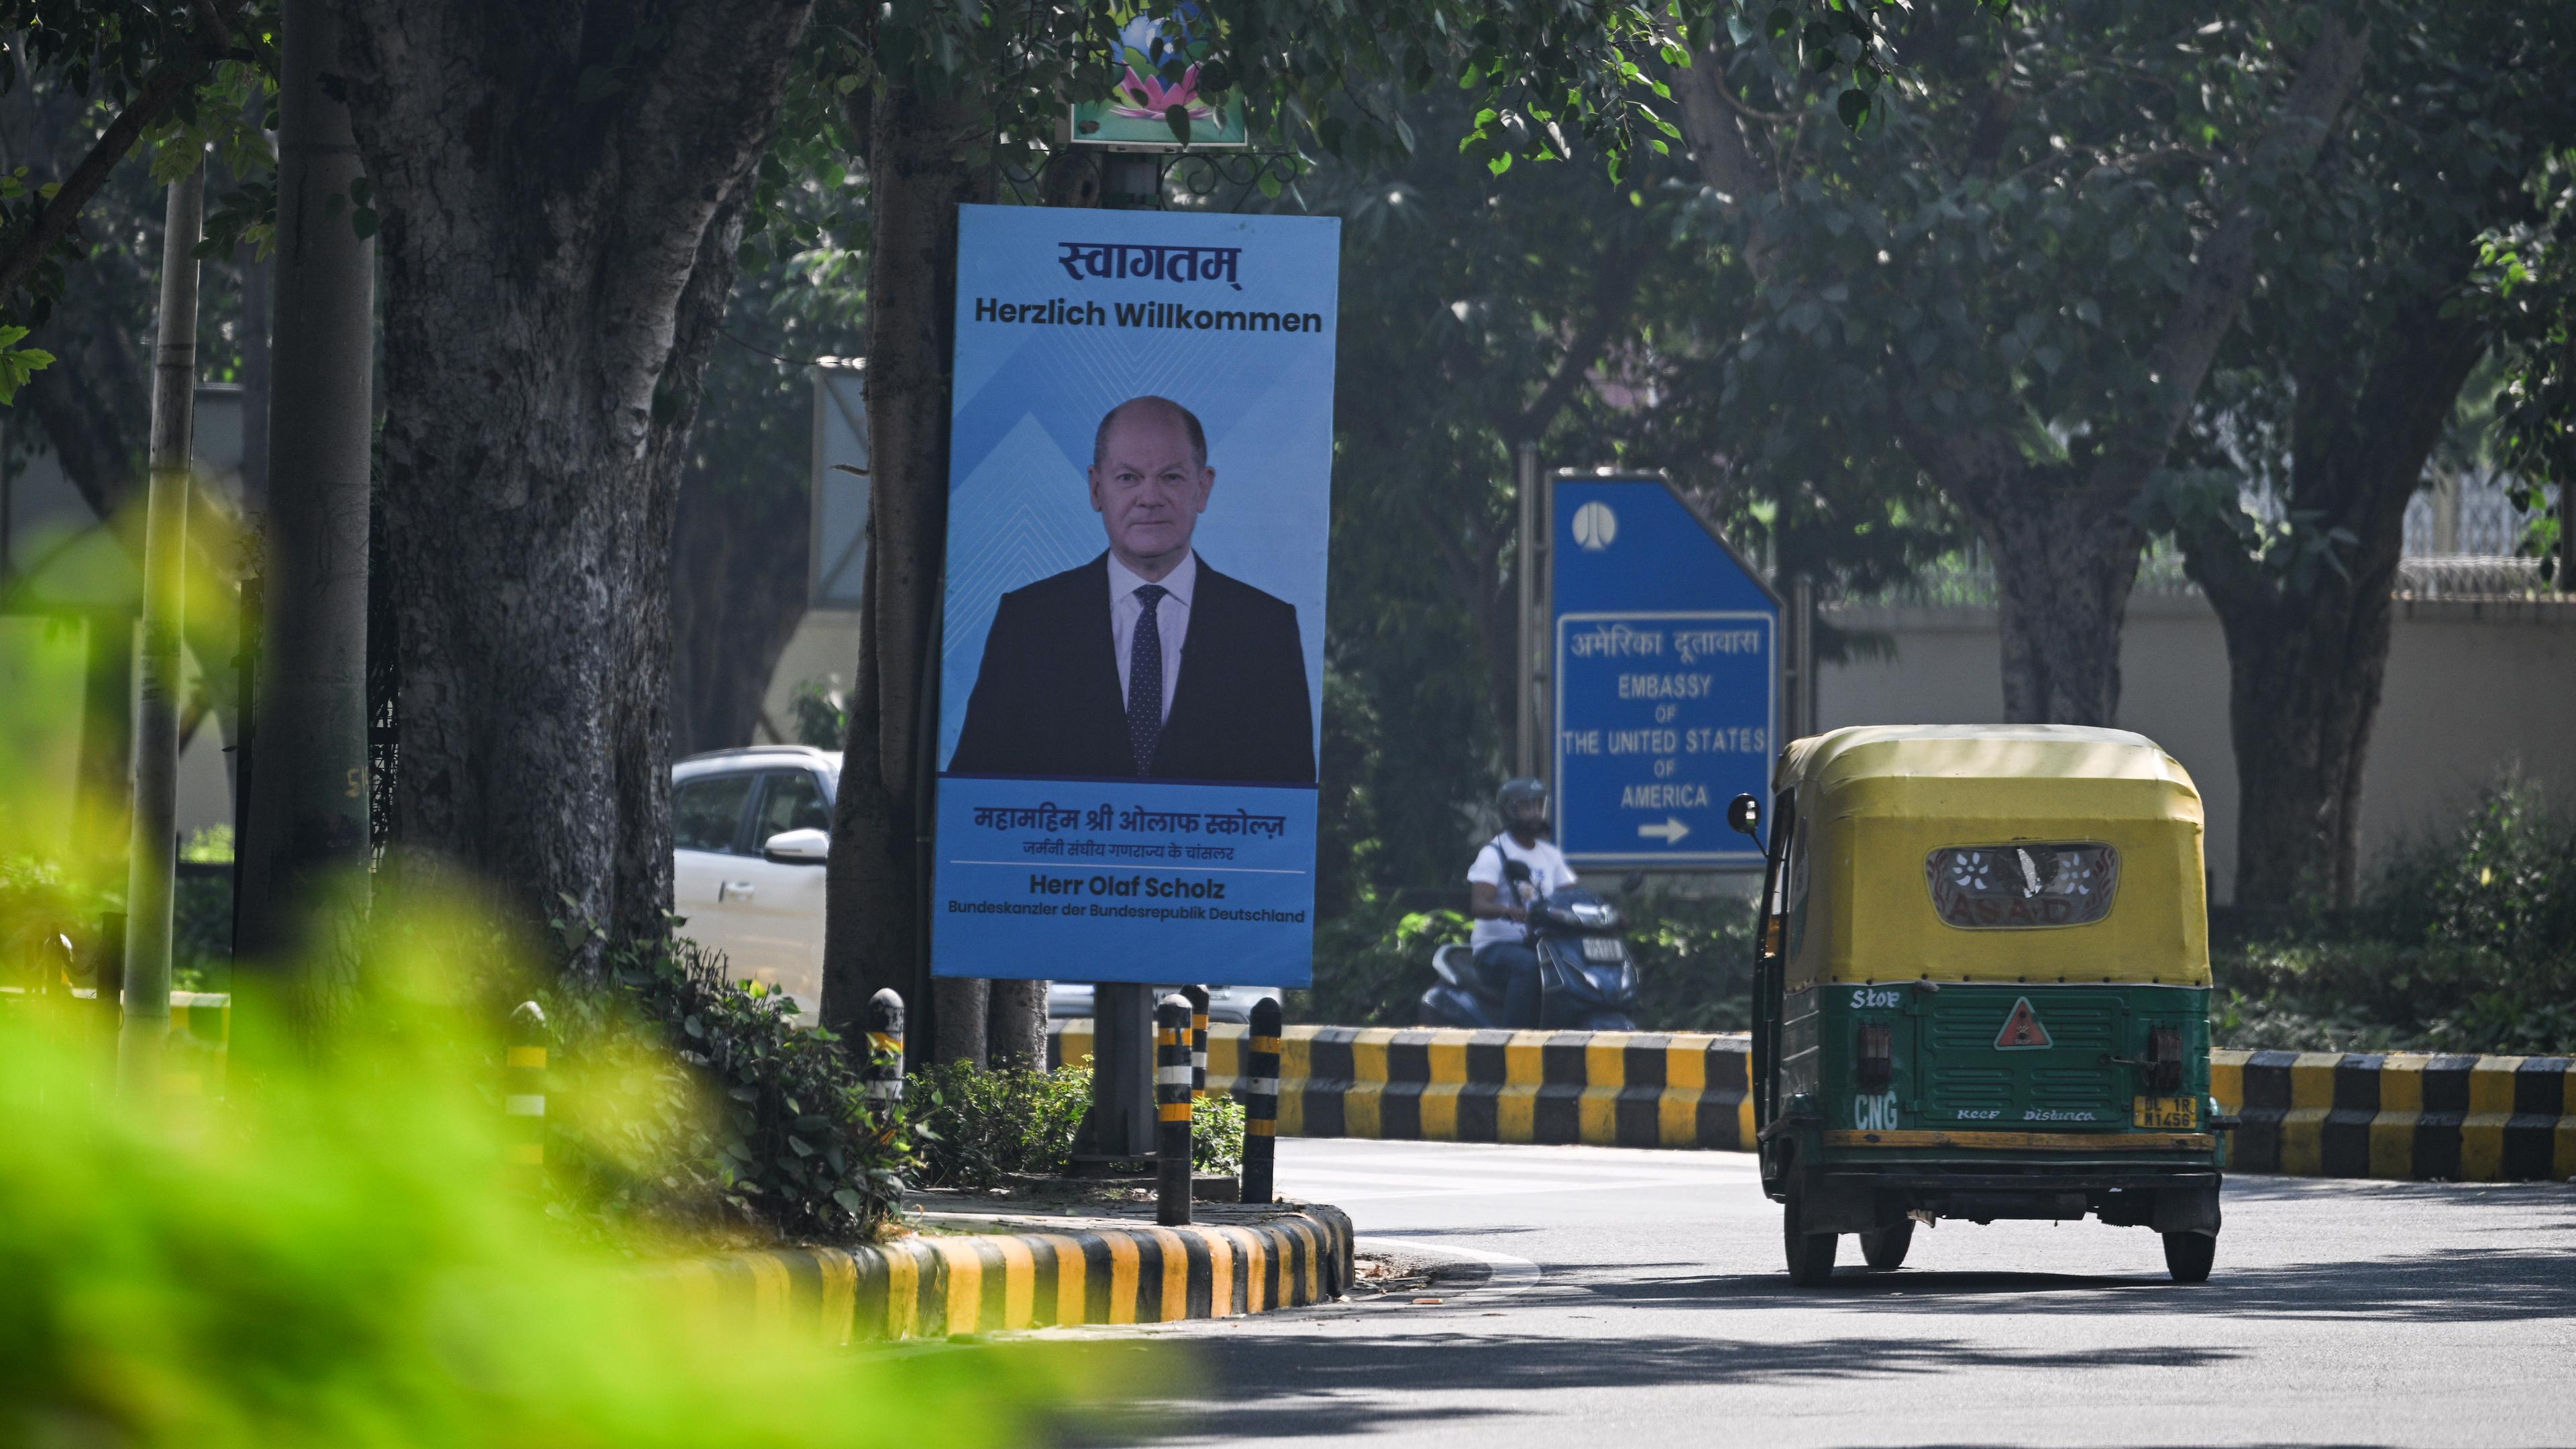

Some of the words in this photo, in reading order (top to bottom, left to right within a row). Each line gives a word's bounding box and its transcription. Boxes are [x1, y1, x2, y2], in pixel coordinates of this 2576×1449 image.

[1059, 242, 1242, 291] स्वागतम्
[975, 298, 1106, 327] Herzlich
[1114, 301, 1322, 333] Willkommen
[1570, 623, 1662, 657] अमेरिका
[1672, 629, 1761, 663] दूतावास
[1618, 674, 1711, 698] EMBASSY
[1654, 704, 1677, 724] OF
[1563, 730, 1599, 755] THE
[1608, 729, 1676, 755] UNITED
[1686, 728, 1766, 753] STATES
[1654, 759, 1675, 778] OF
[1621, 784, 1709, 809] AMERICA
[973, 801, 1080, 832] महामहिम
[1084, 803, 1114, 831] श्री
[1118, 805, 1201, 833] ओलाफ
[1204, 808, 1286, 839] स्कोल्ज़
[1022, 839, 1065, 855] जर्मनी
[1067, 840, 1106, 857] संघीय
[1108, 843, 1165, 859] गणराज्य
[1168, 843, 1183, 859] के
[1185, 843, 1235, 860] चांसलर
[1030, 874, 1083, 894] Herr
[1089, 875, 1140, 896] Olaf
[1145, 877, 1225, 899] Scholz
[948, 900, 1057, 915] Bundeskanzler
[1061, 903, 1086, 916] der
[1089, 904, 1205, 922] Bundesrepublik
[1210, 907, 1305, 924] Deutschland
[1946, 892, 2073, 925] ASAD
[1854, 1094, 1898, 1130] CNG
